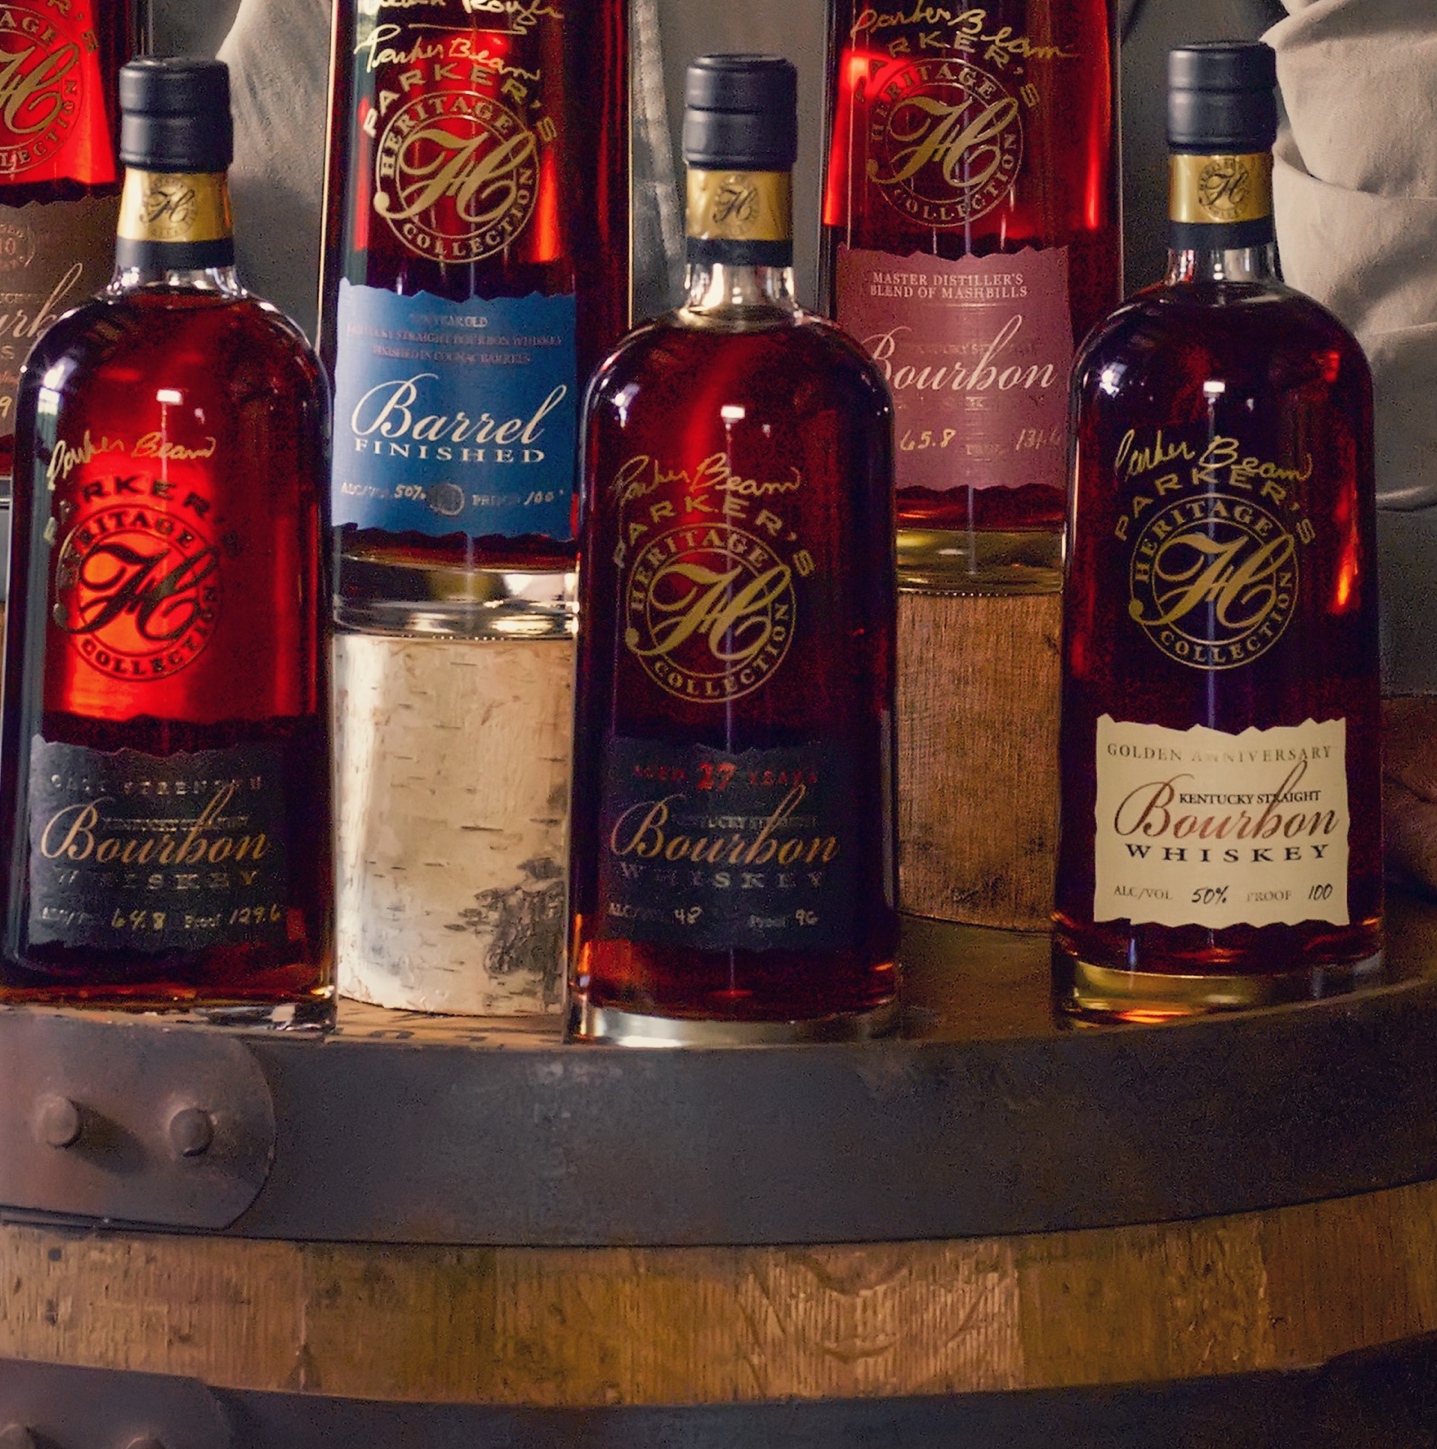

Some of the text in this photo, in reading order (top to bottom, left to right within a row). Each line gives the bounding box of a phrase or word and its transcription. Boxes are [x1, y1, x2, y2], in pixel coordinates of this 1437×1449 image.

[363, 62, 558, 142] PARKER'S
[855, 31, 1041, 108] PARKER'S
[871, 63, 997, 142] HERITAGE
[380, 97, 513, 179] HERITAGE
[893, 133, 1017, 222] COLLECTION
[403, 168, 533, 257] COLLECTION
[870, 286, 1028, 299] BLEND OF MASHBILLS
[873, 271, 1024, 286] MASTER DISTILLER'S
[860, 314, 1058, 391] Bourbon
[351, 373, 567, 445] Barrel
[900, 428, 957, 451] 65.8
[355, 438, 545, 463] FINISHED
[614, 494, 814, 578] PARKER'S
[1114, 466, 1316, 546] PARKER'S
[1134, 499, 1274, 584] HERITAGE
[630, 528, 768, 612] HERITAGE
[654, 602, 789, 697] COLLECTION
[1161, 570, 1294, 663] COLLECTION
[696, 762, 737, 792] 27
[1107, 743, 1332, 763] GOLDEN ANNIVERSARY
[41, 781, 270, 864] Bourbon
[612, 783, 840, 866] Bourbon
[1114, 759, 1340, 840] Bourbon
[1179, 789, 1322, 805] KENTUCKY STRAIGHT
[1125, 843, 1330, 863] WHISKEY
[1113, 883, 1333, 904] ALC/VOL 50% PROOF 100
